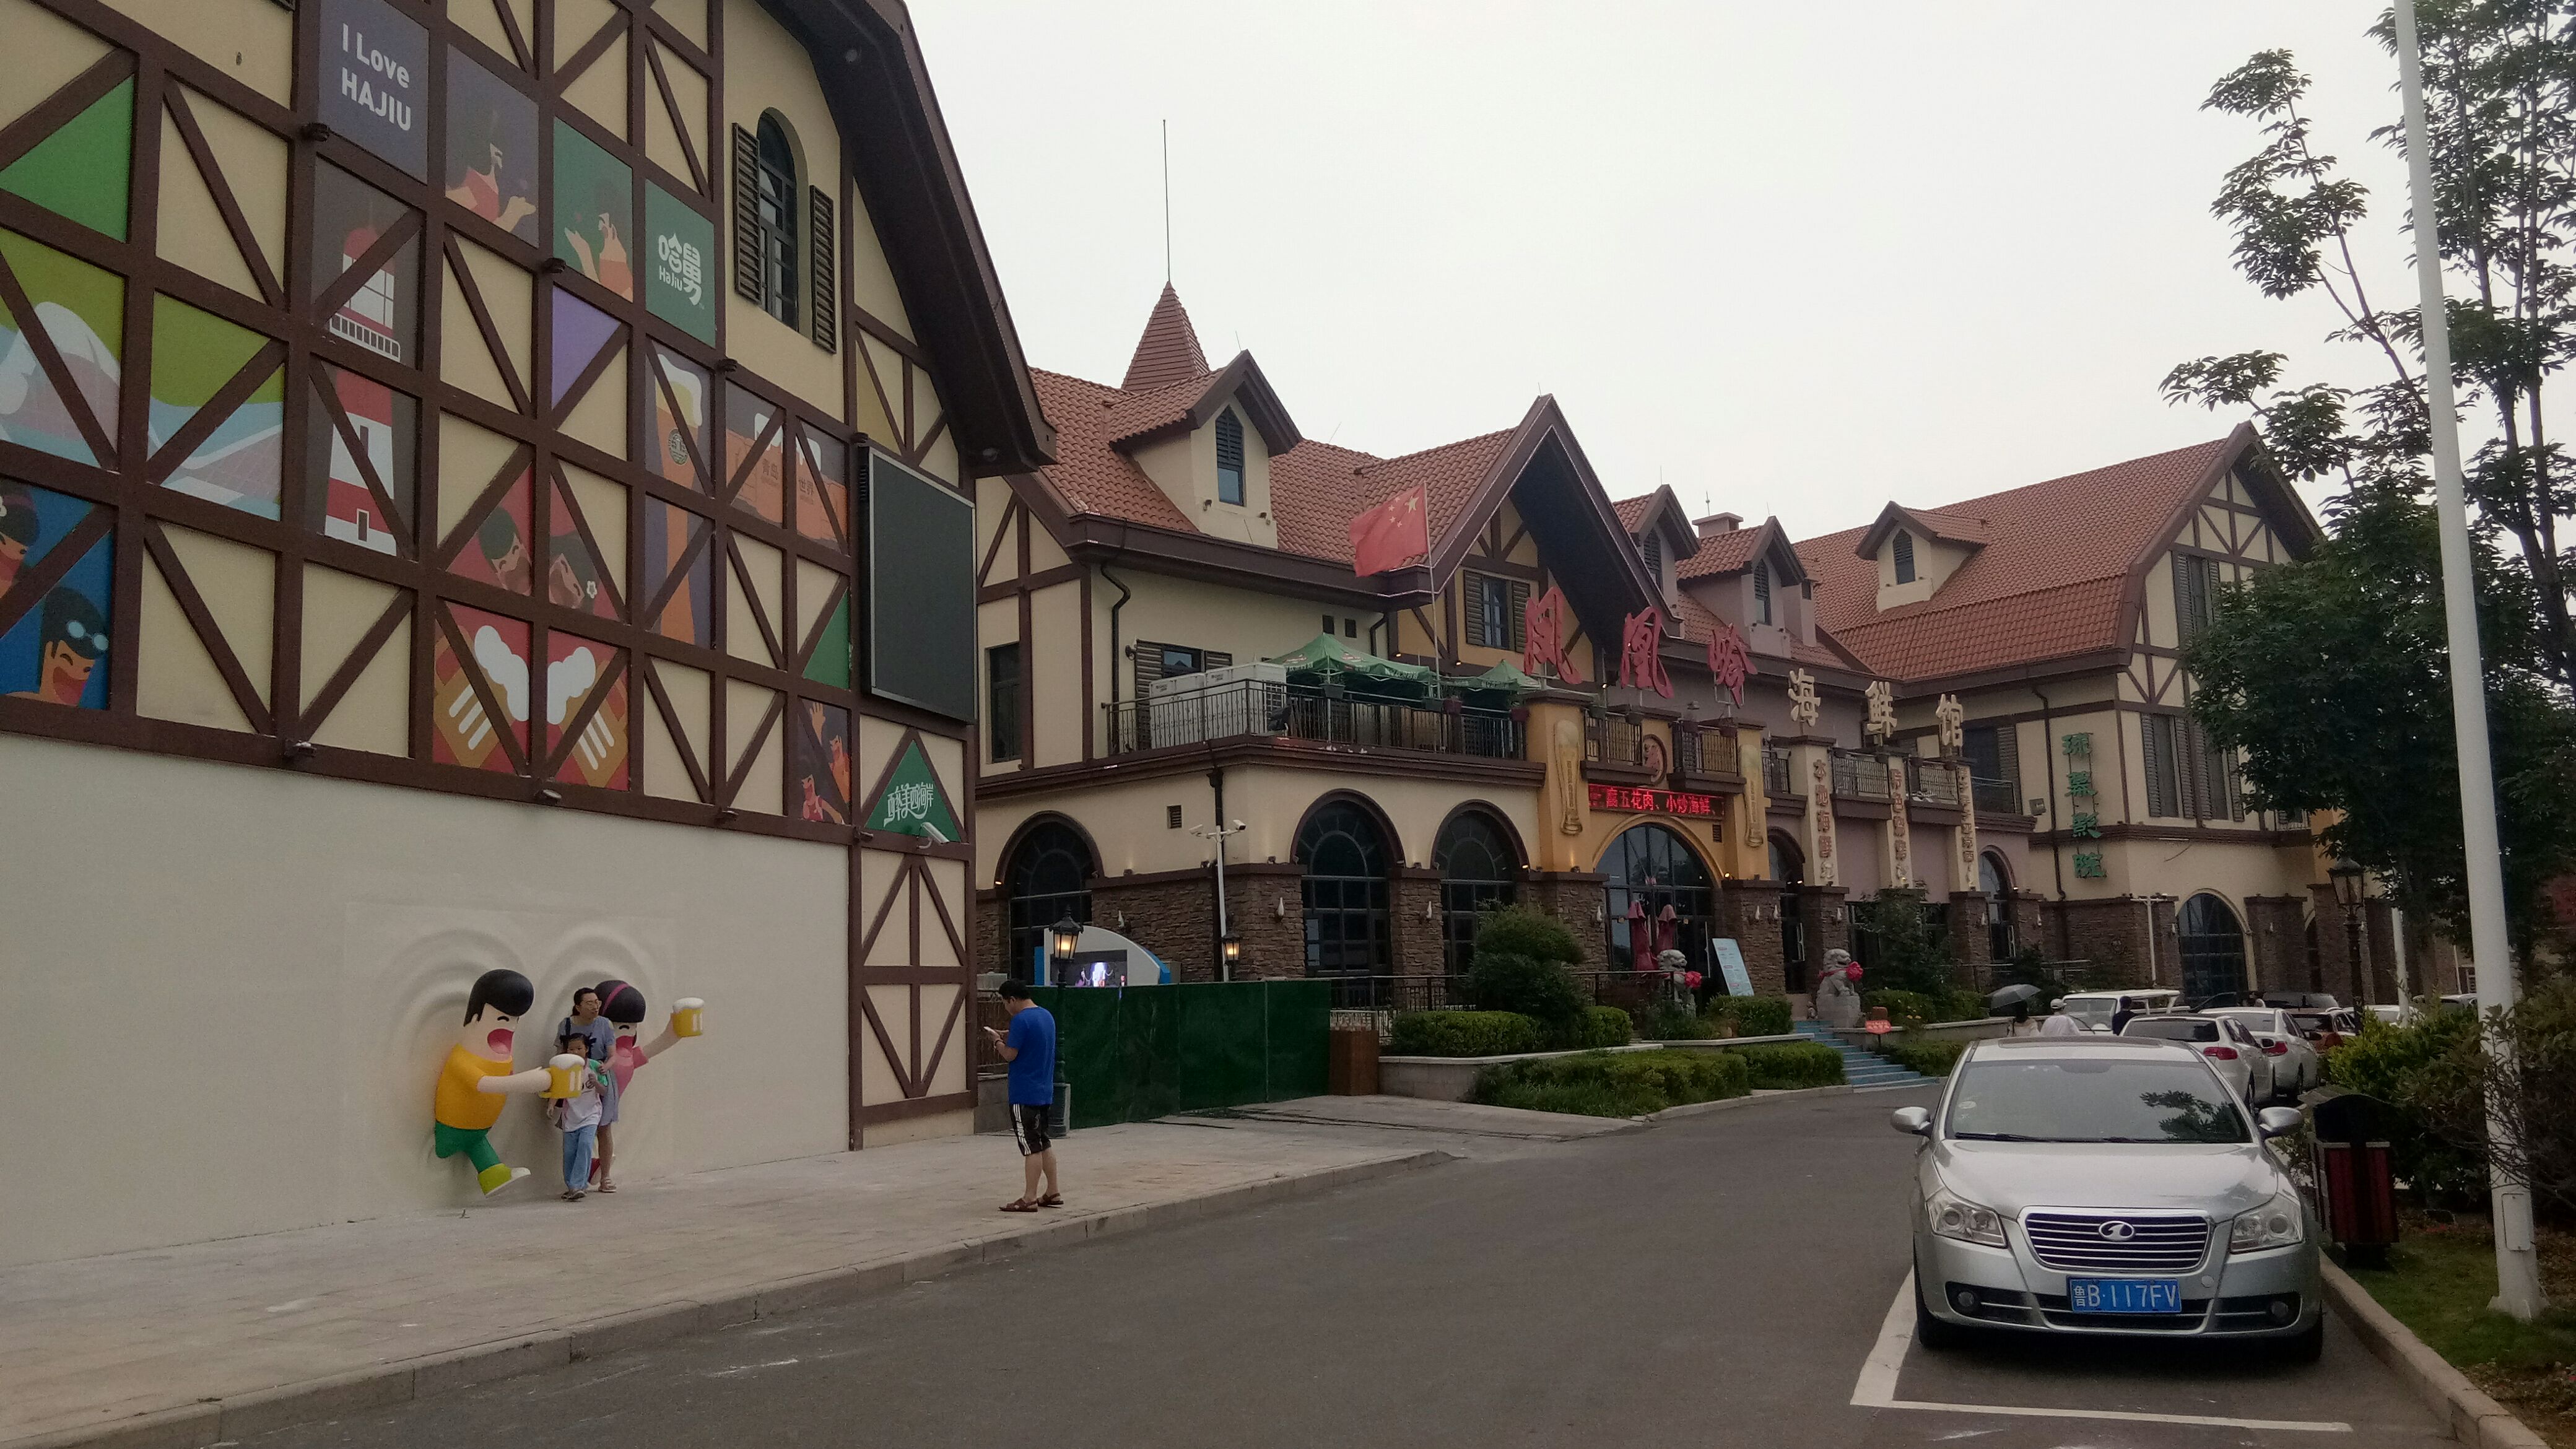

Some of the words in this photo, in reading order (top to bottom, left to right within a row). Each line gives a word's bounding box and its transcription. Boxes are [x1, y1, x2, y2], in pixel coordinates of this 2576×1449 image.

[342, 23, 349, 52] I
[356, 32, 410, 89] Love
[342, 67, 411, 131] HAJIU
[658, 233, 702, 305] 哈舅
[762, 458, 779, 480] 青岛
[798, 476, 814, 495] 世界
[1788, 668, 1964, 747] 海鲜馆
